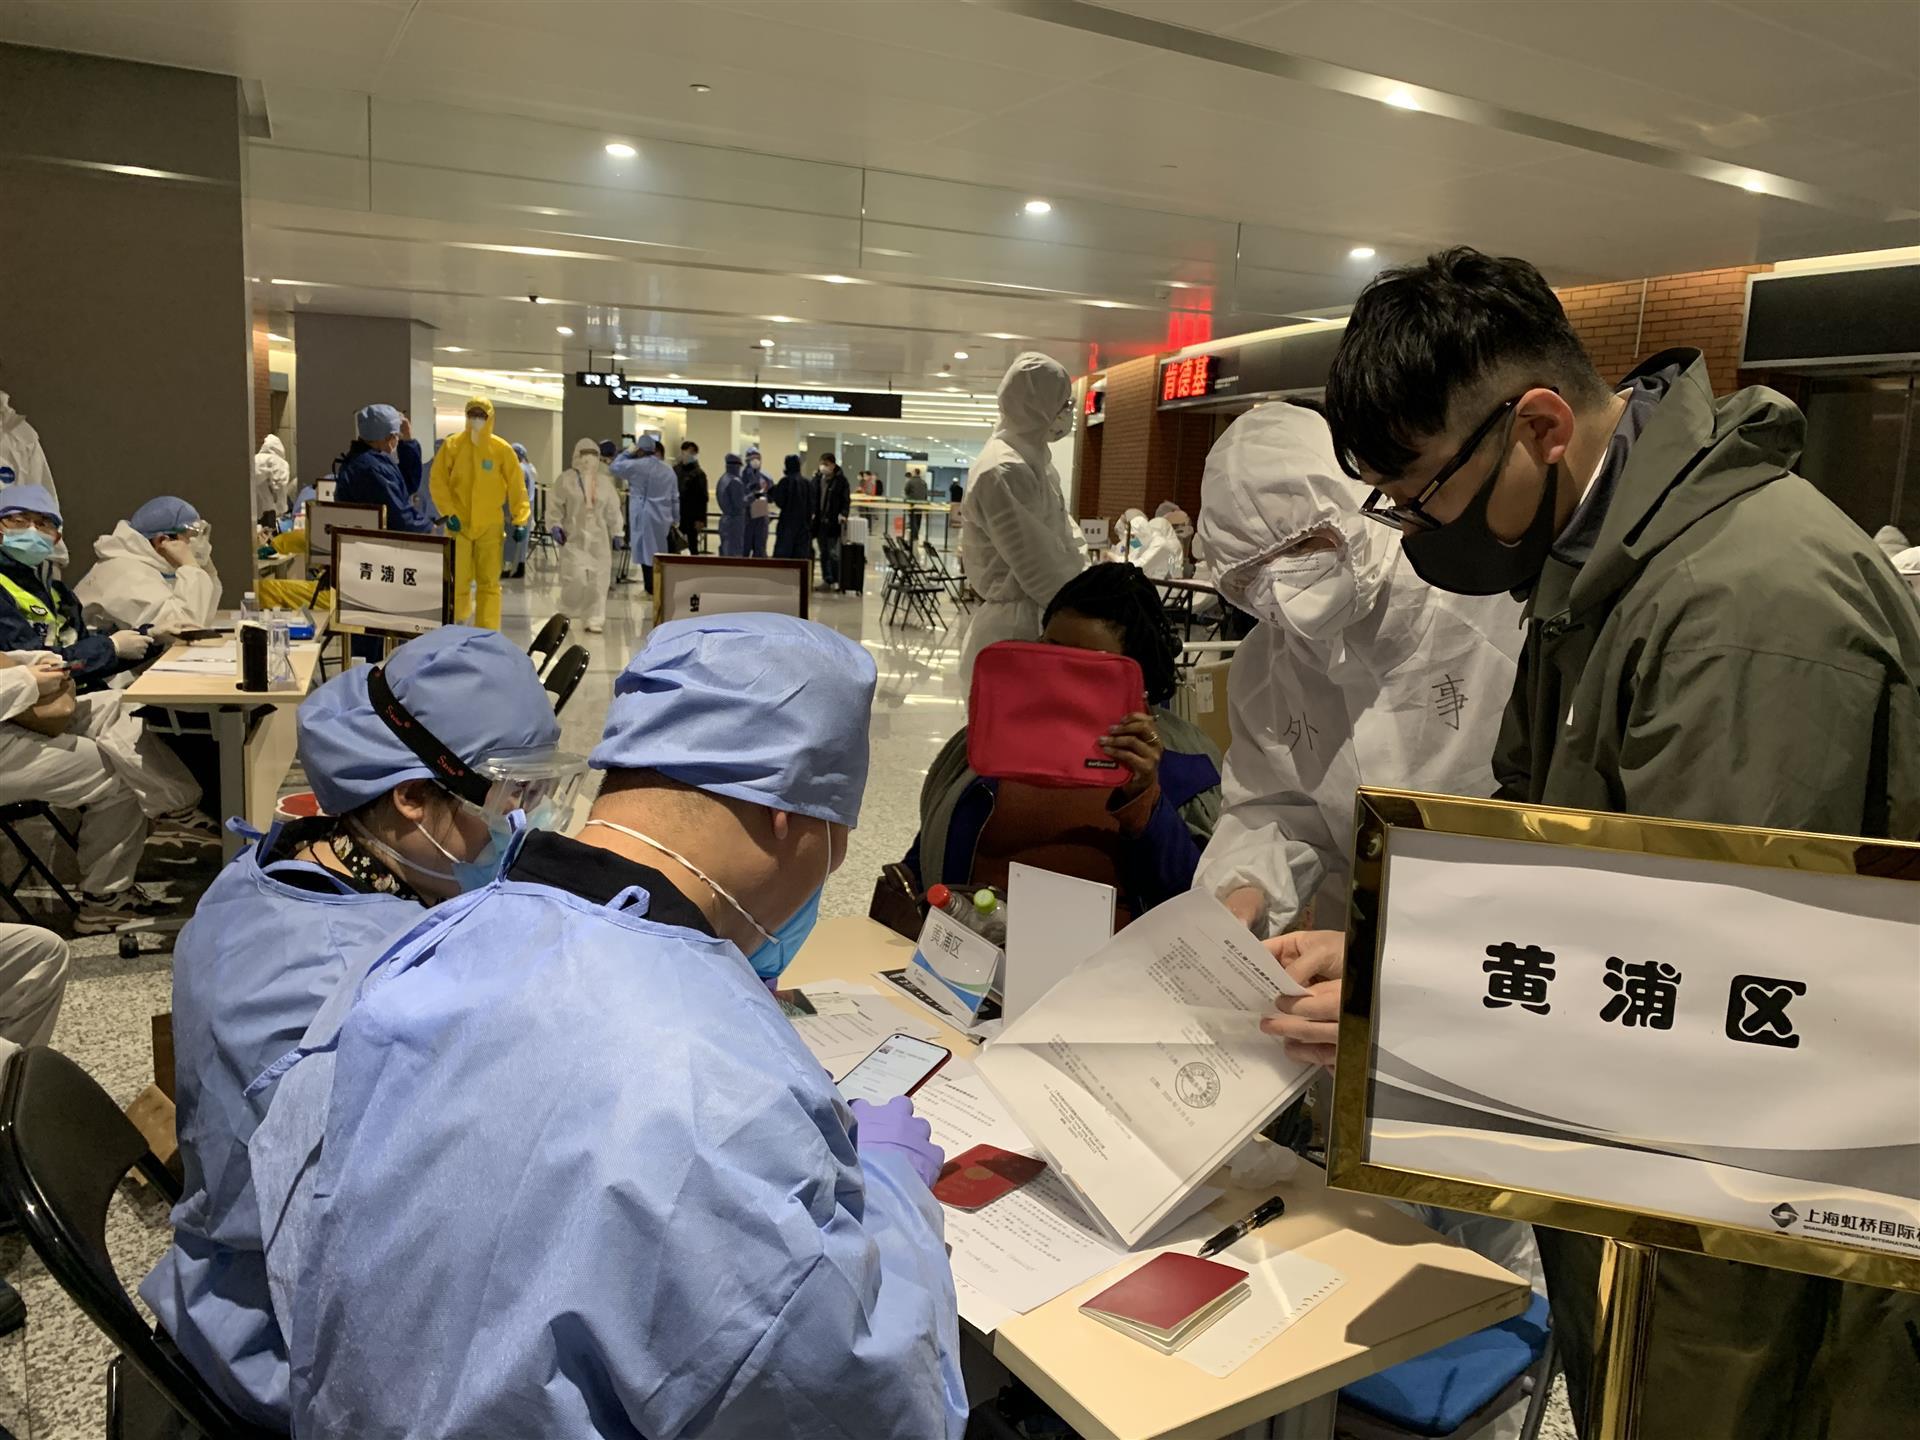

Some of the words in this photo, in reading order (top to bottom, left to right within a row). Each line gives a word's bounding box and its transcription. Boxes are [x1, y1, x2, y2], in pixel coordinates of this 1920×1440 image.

[1163, 354, 1211, 401] 肯德基
[359, 562, 418, 586] 青浦区
[1431, 673, 1469, 731] 事
[1283, 711, 1319, 755] 外
[930, 923, 964, 959] 黄浦区
[1482, 941, 1807, 1049] 黄浦区
